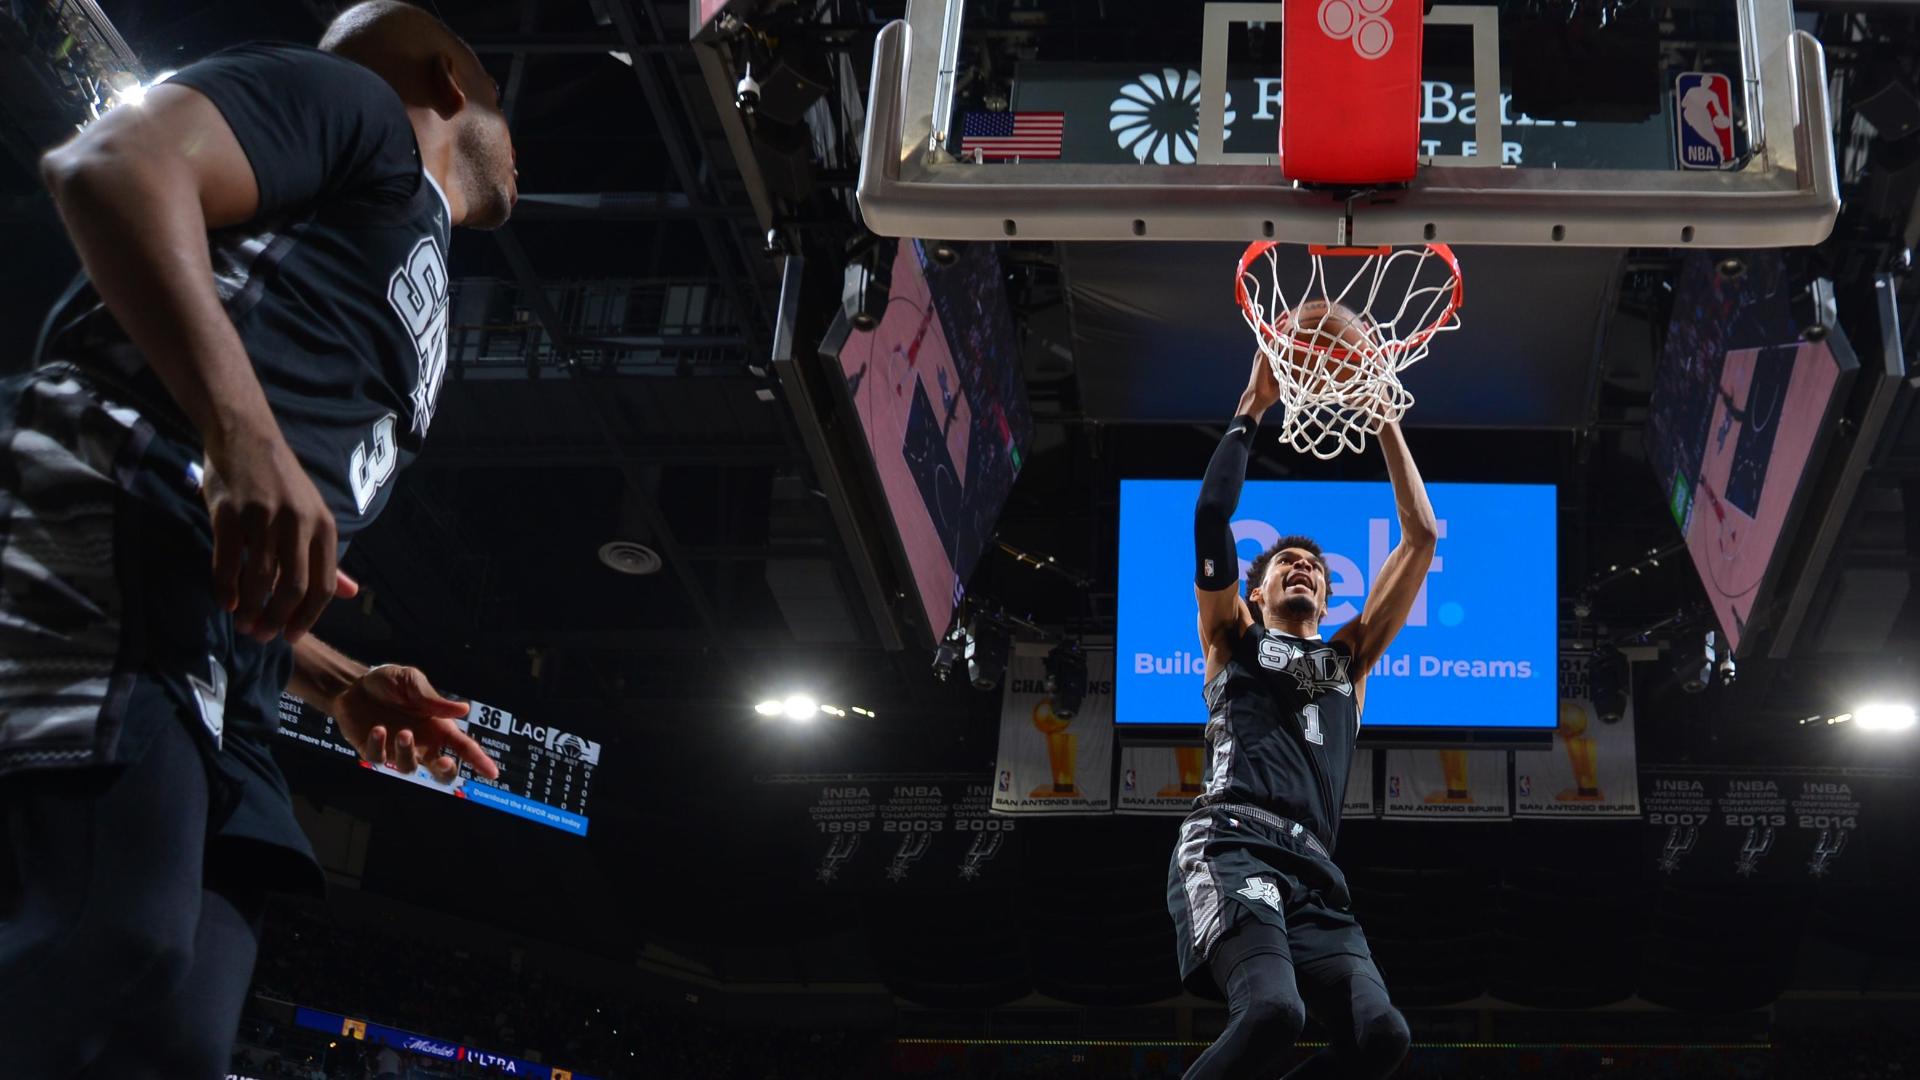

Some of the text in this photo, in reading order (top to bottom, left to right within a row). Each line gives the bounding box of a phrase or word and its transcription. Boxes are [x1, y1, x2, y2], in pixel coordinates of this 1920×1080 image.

[1688, 146, 1714, 161] NBA
[349, 412, 398, 515] 3
[1258, 638, 1353, 697] SATX
[1368, 653, 1410, 677] ild
[1011, 679, 1111, 695] CHANS
[279, 701, 302, 715] SSELL
[479, 706, 503, 729] 36
[511, 718, 546, 742] LAC
[1303, 704, 1324, 745] 1
[900, 786, 943, 797] NBA
[1663, 780, 1704, 791] NBA
[1736, 780, 1778, 791] NBA
[1810, 783, 1852, 794] NBA
[830, 787, 871, 798] NBA
[473, 788, 508, 806] Download
[509, 800, 522, 811] the
[995, 798, 1018, 806] SAN
[1020, 798, 1070, 806] ANTONIO
[1122, 797, 1146, 805] SAN
[1416, 804, 1465, 812] ANTONIO
[1545, 803, 1596, 811] ANTONIO
[955, 819, 1016, 831] 2005
[1649, 813, 1708, 826] 2007
[1725, 814, 1786, 826] 2013
[1799, 815, 1858, 829] 2014
[816, 821, 871, 833] 1999
[883, 820, 943, 832] 2003
[403, 1037, 456, 1057] Michelob
